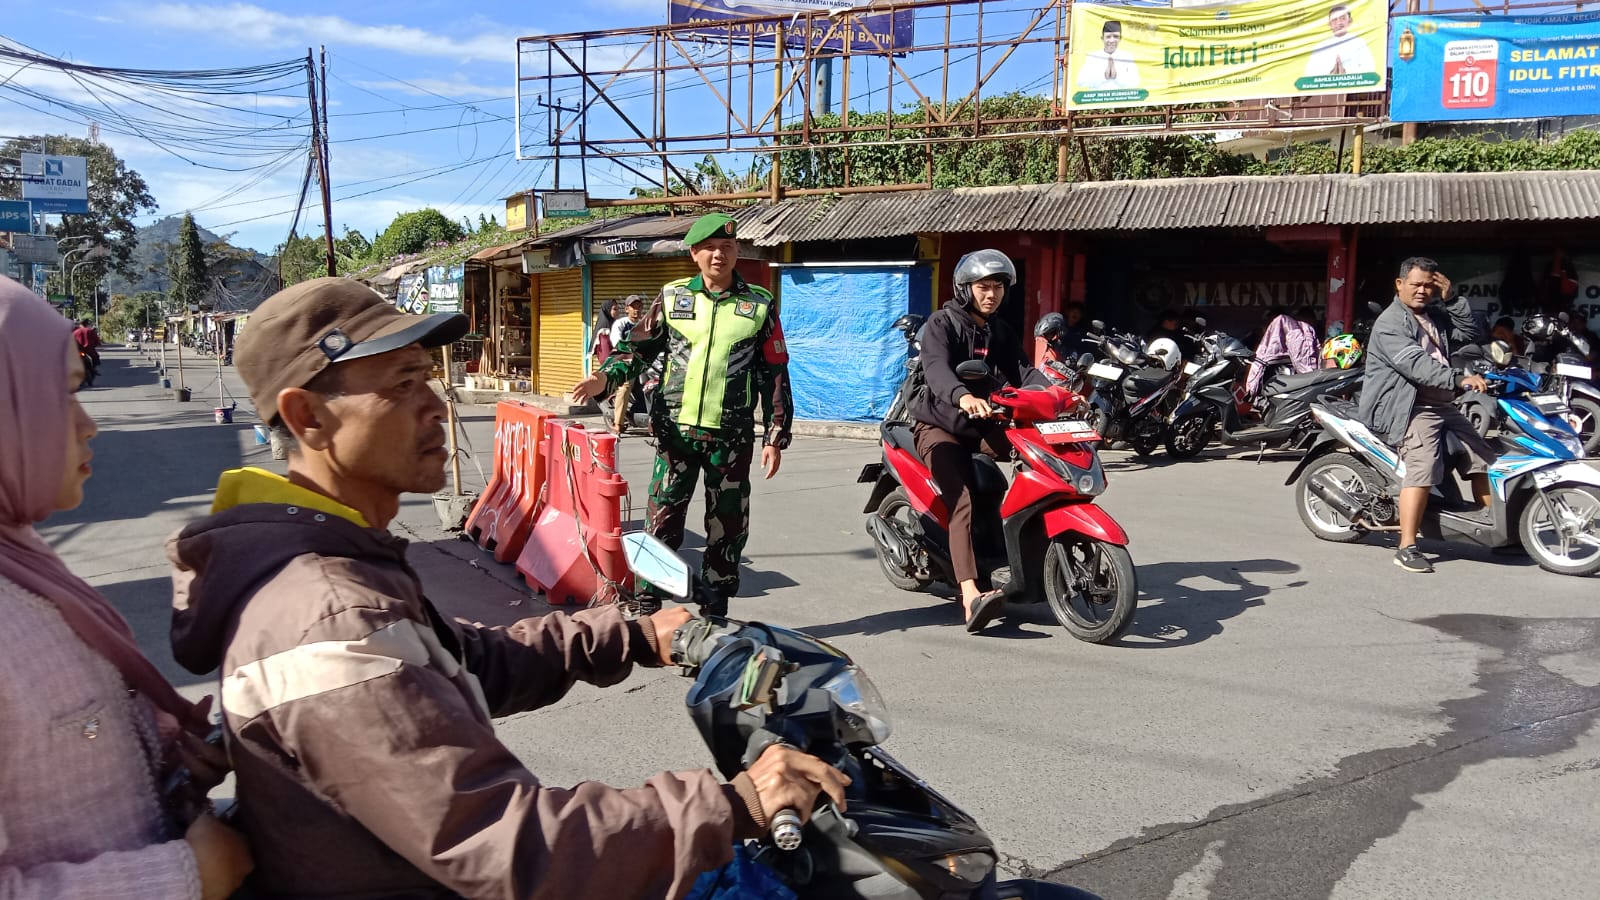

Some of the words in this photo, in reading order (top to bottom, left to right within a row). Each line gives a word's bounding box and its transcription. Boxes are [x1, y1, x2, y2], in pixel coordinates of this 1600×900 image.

[688, 17, 741, 32] MOON
[744, 22, 780, 33] MAA
[785, 25, 823, 39] LAHR
[1163, 44, 1205, 69] Idul
[1208, 41, 1258, 66] Fitri
[1510, 46, 1600, 62] SELAMAT
[1509, 67, 1553, 81] IDUL
[1449, 71, 1490, 98] 110
[1508, 87, 1532, 95] MOHON
[57, 179, 81, 187] GADAI
[605, 240, 638, 255] FILTER
[1183, 280, 1329, 307] MAGNUM
